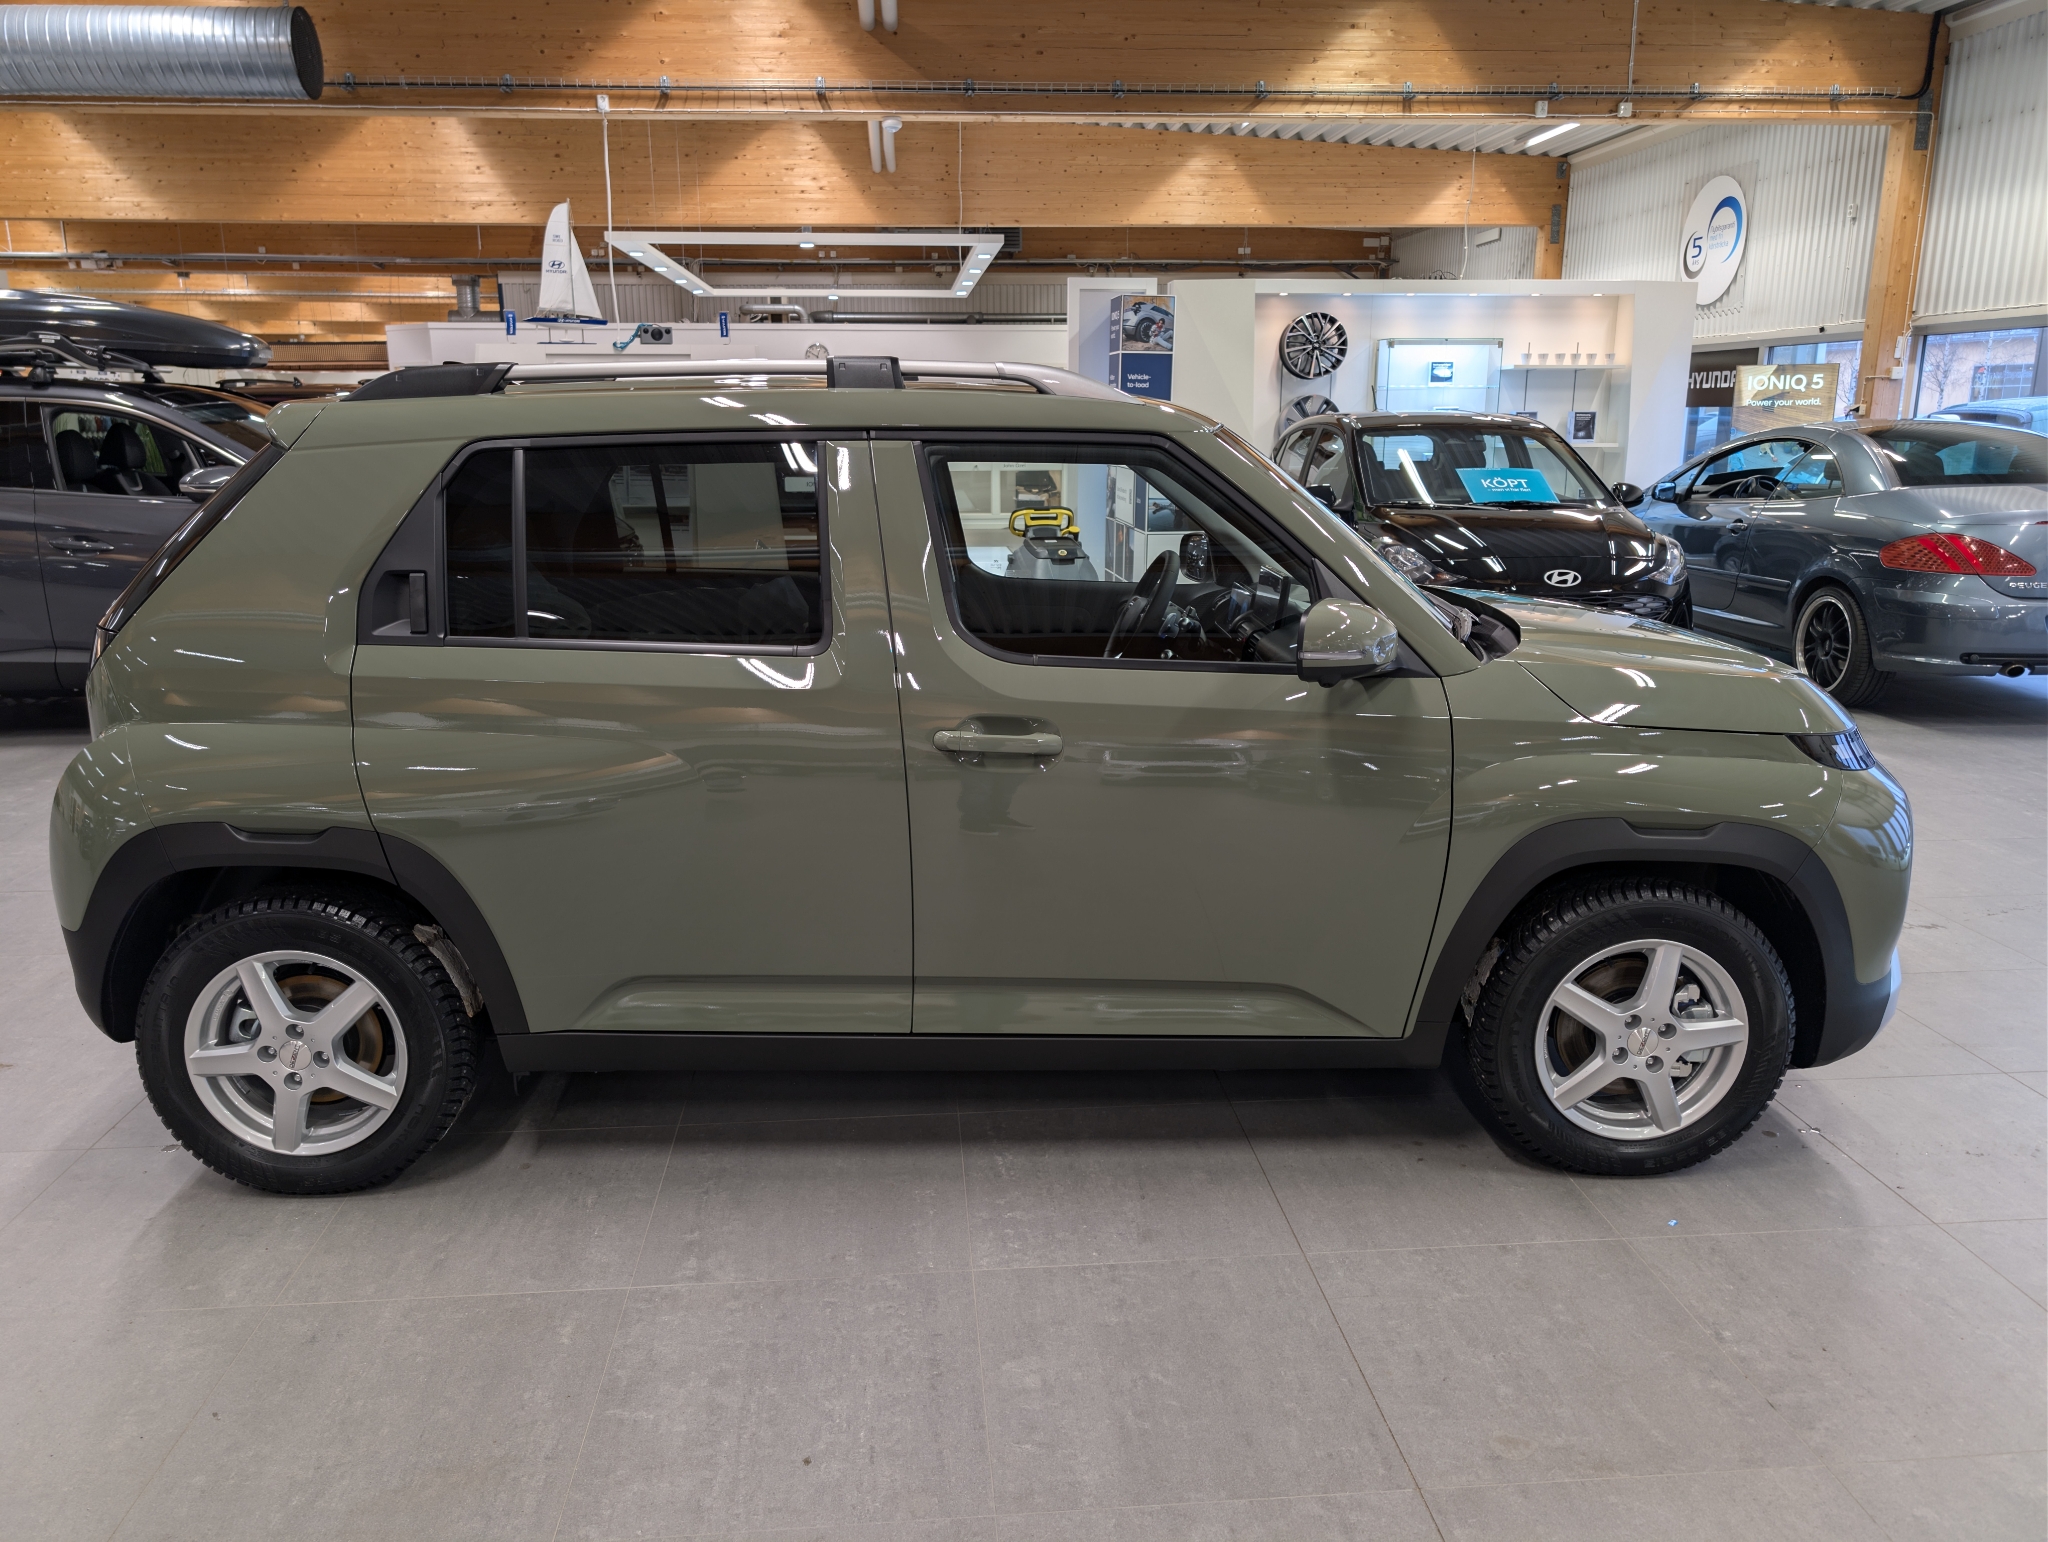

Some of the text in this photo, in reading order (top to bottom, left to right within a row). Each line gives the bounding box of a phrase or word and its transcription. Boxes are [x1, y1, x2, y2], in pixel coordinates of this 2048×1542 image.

[1691, 236, 1703, 259] 5
[1689, 370, 1736, 389] HYUNDA
[1747, 373, 1824, 392] IONIQ 5
[1745, 398, 1821, 410] Power your world.
[1481, 477, 1528, 488] KÖPT
